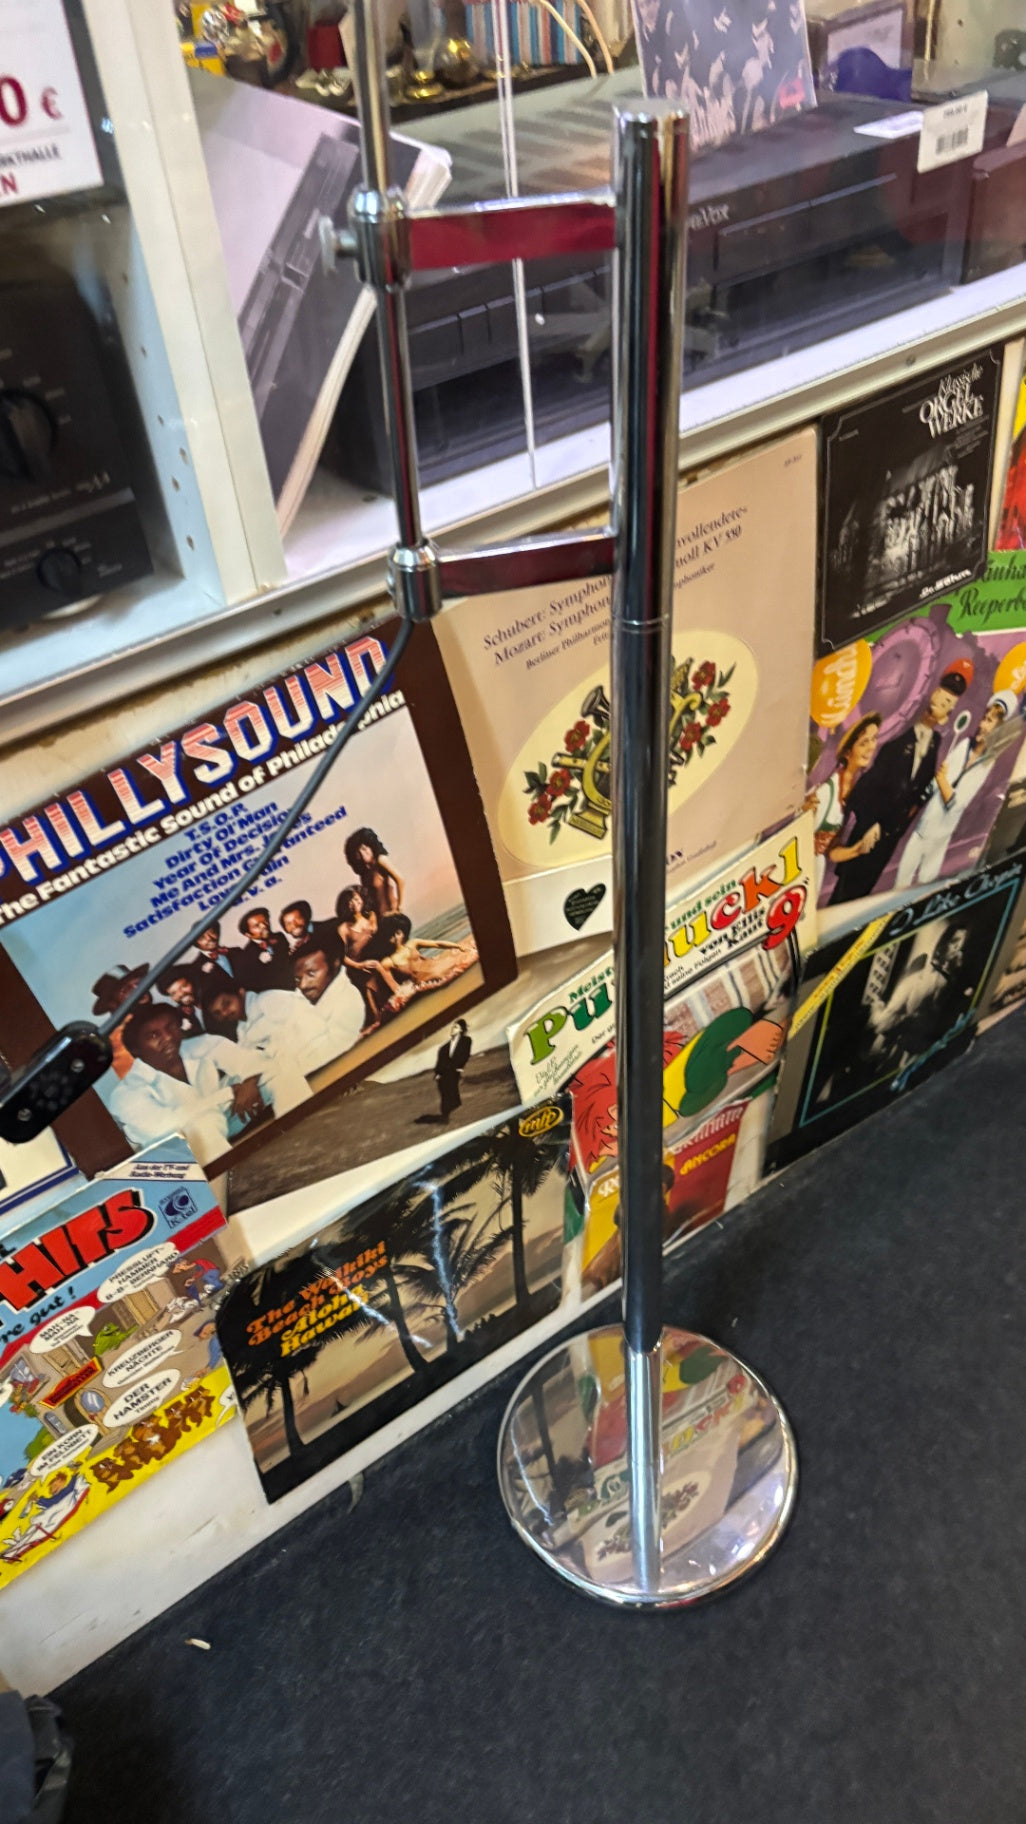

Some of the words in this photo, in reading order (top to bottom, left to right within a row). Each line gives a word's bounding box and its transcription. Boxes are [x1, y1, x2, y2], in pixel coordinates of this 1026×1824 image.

[41, 87, 63, 119] €
[0, 172, 18, 196] N
[0, 635, 392, 885] HILLYSOUND
[36, 826, 162, 901] Fantastic
[161, 781, 239, 833] Sound
[240, 767, 265, 794] of
[153, 861, 197, 891] Year
[199, 846, 221, 866] Of
[223, 807, 293, 853] Decisio
[165, 836, 212, 870] Dirty
[150, 886, 180, 909] Me
[183, 863, 219, 894] And
[220, 845, 261, 870] Mrs.
[198, 883, 239, 912] Lov
[122, 868, 241, 939] Satisfaction
[671, 901, 702, 929] und
[704, 880, 738, 905] sein
[762, 884, 808, 951] 9
[0, 1186, 156, 1313] HITS
[30, 1295, 65, 1325] gut
[246, 1300, 296, 1333] The
[248, 1294, 326, 1346] Beach
[113, 1377, 172, 1420] HAMSTER
[123, 1382, 150, 1402] DER
